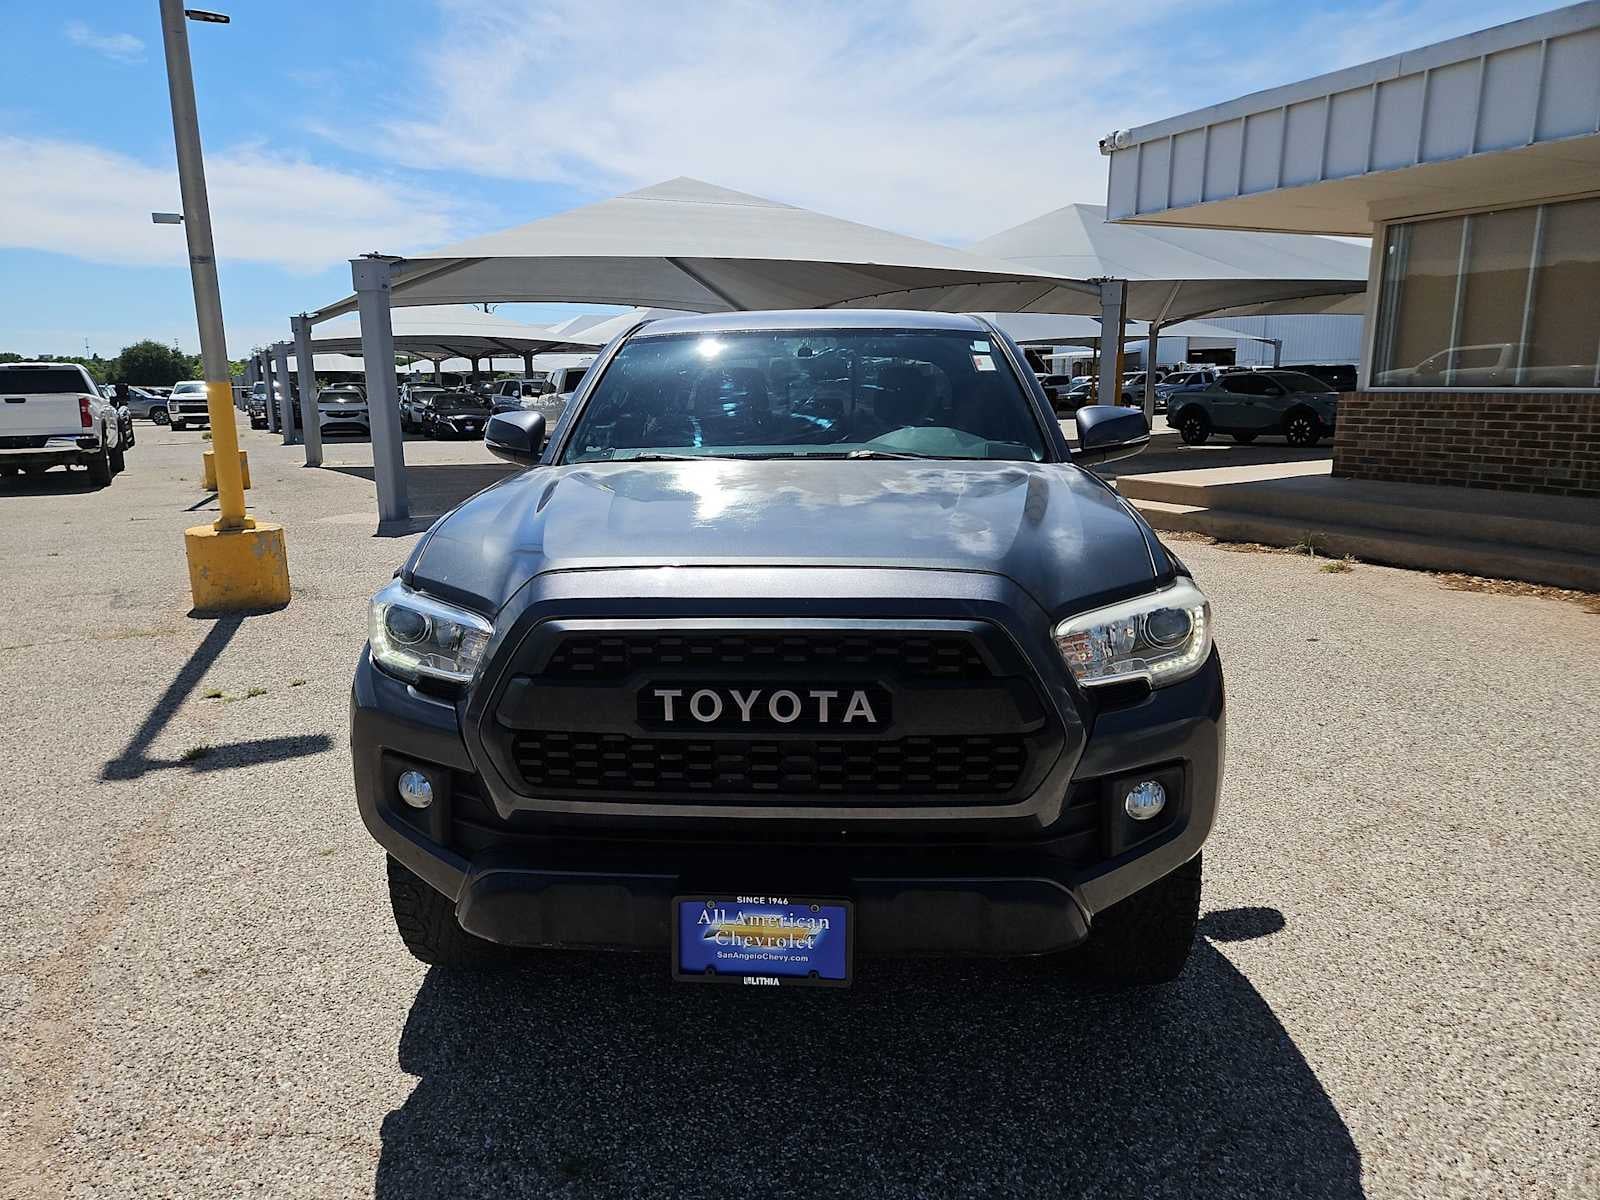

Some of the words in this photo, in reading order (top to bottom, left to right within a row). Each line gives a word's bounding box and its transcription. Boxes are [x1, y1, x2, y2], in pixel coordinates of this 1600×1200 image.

[654, 689, 877, 723] TOYOTA
[736, 896, 765, 905] SINCE
[768, 896, 789, 905] 1946
[697, 909, 726, 925] All
[734, 911, 830, 930] American
[715, 930, 815, 950] Chevrolet
[717, 951, 809, 963] SanAngeloChevy.com
[751, 977, 780, 986] LITHIA
